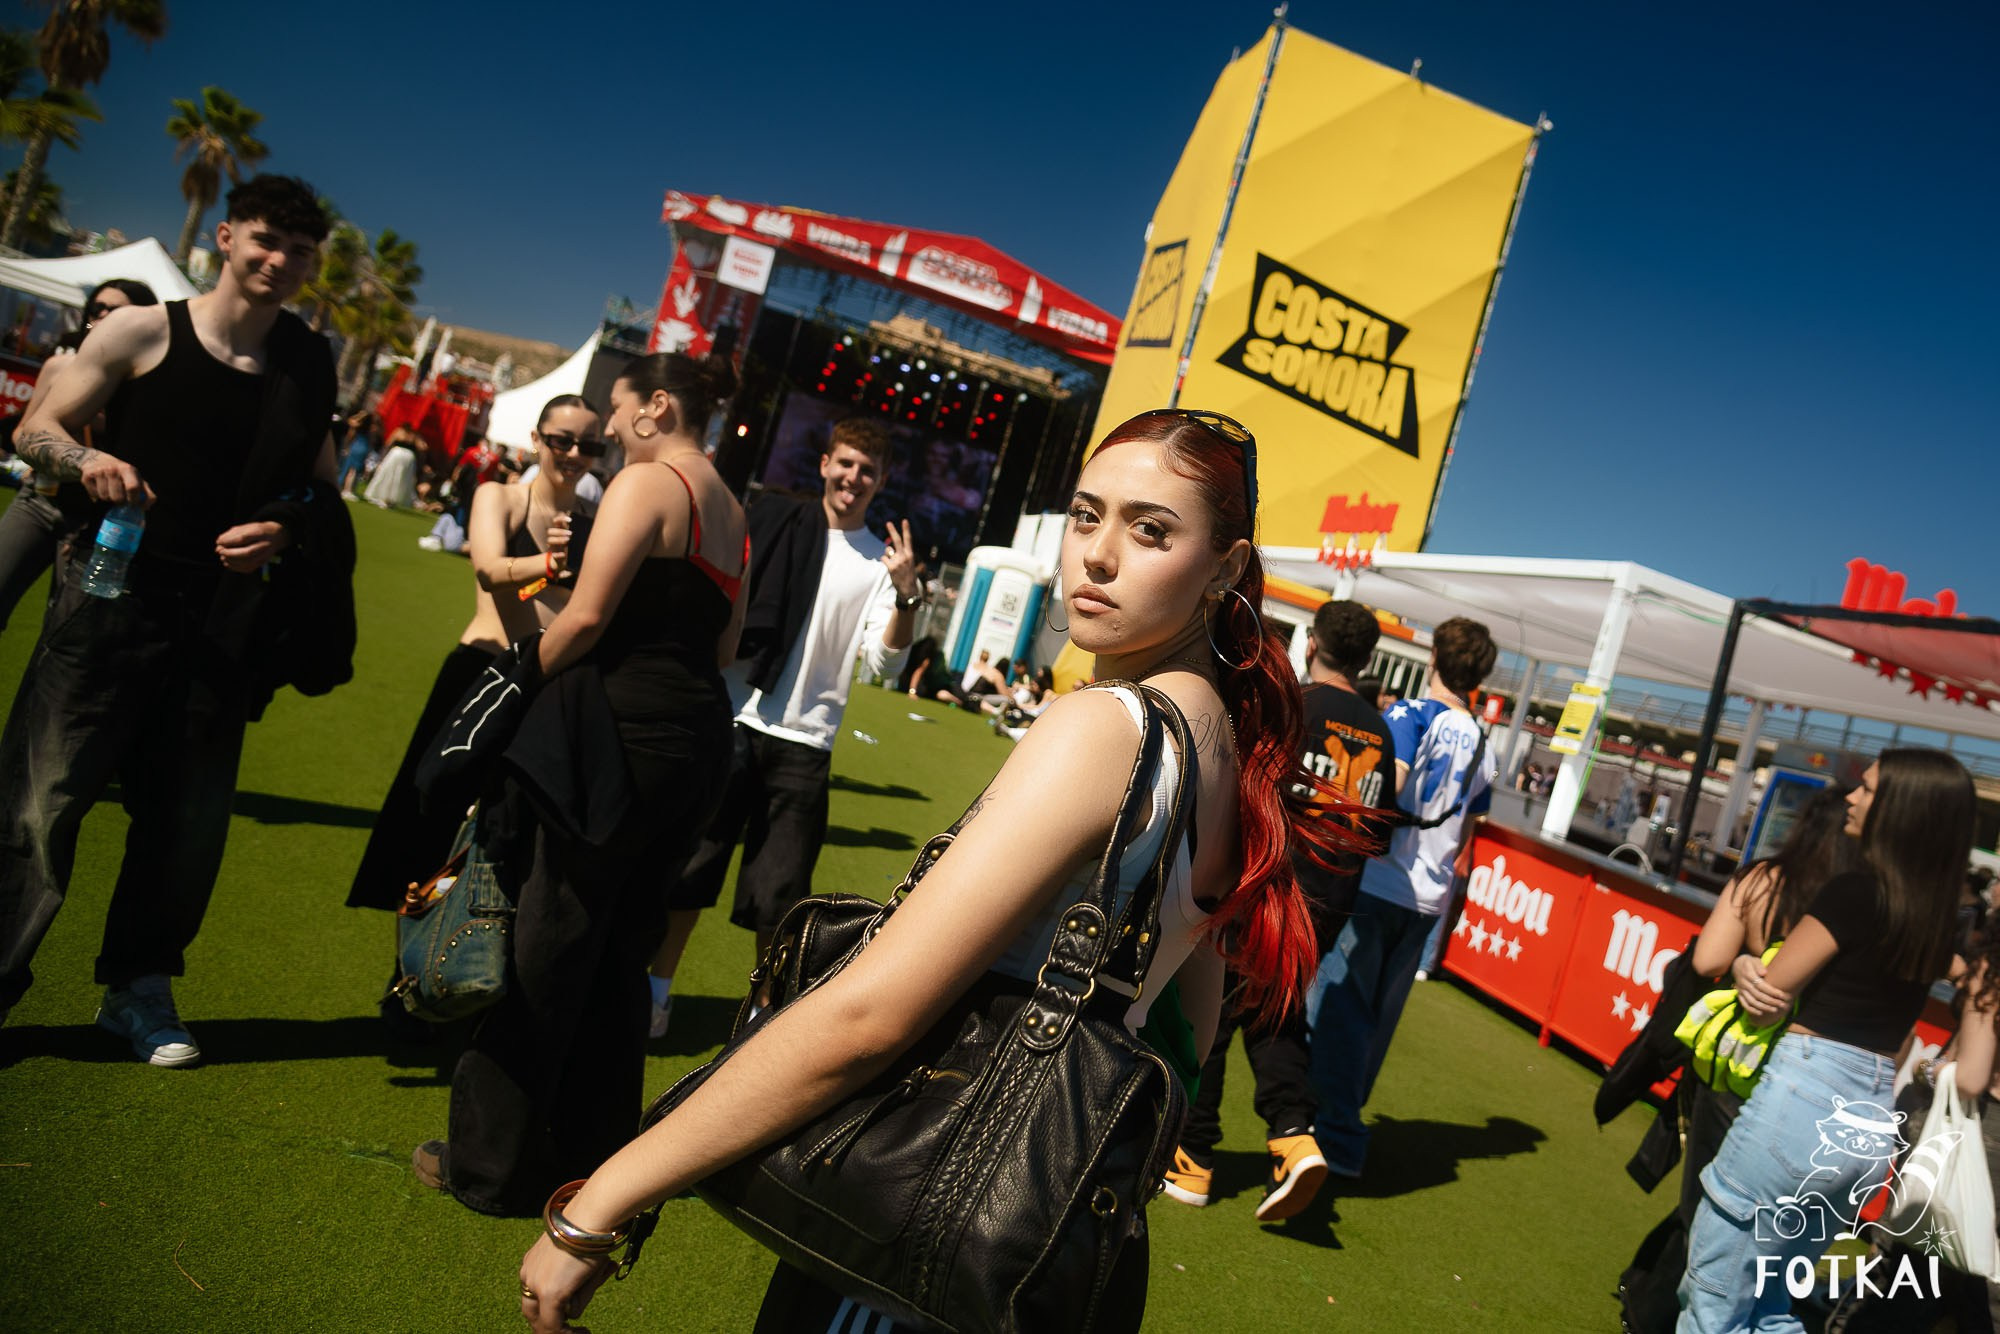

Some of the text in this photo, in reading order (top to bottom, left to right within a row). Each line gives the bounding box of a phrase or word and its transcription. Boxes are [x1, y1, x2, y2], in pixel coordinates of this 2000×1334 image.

[1253, 270, 1390, 360] COSTA
[1242, 338, 1410, 441] SONORA
[1467, 855, 1554, 936] ahou
